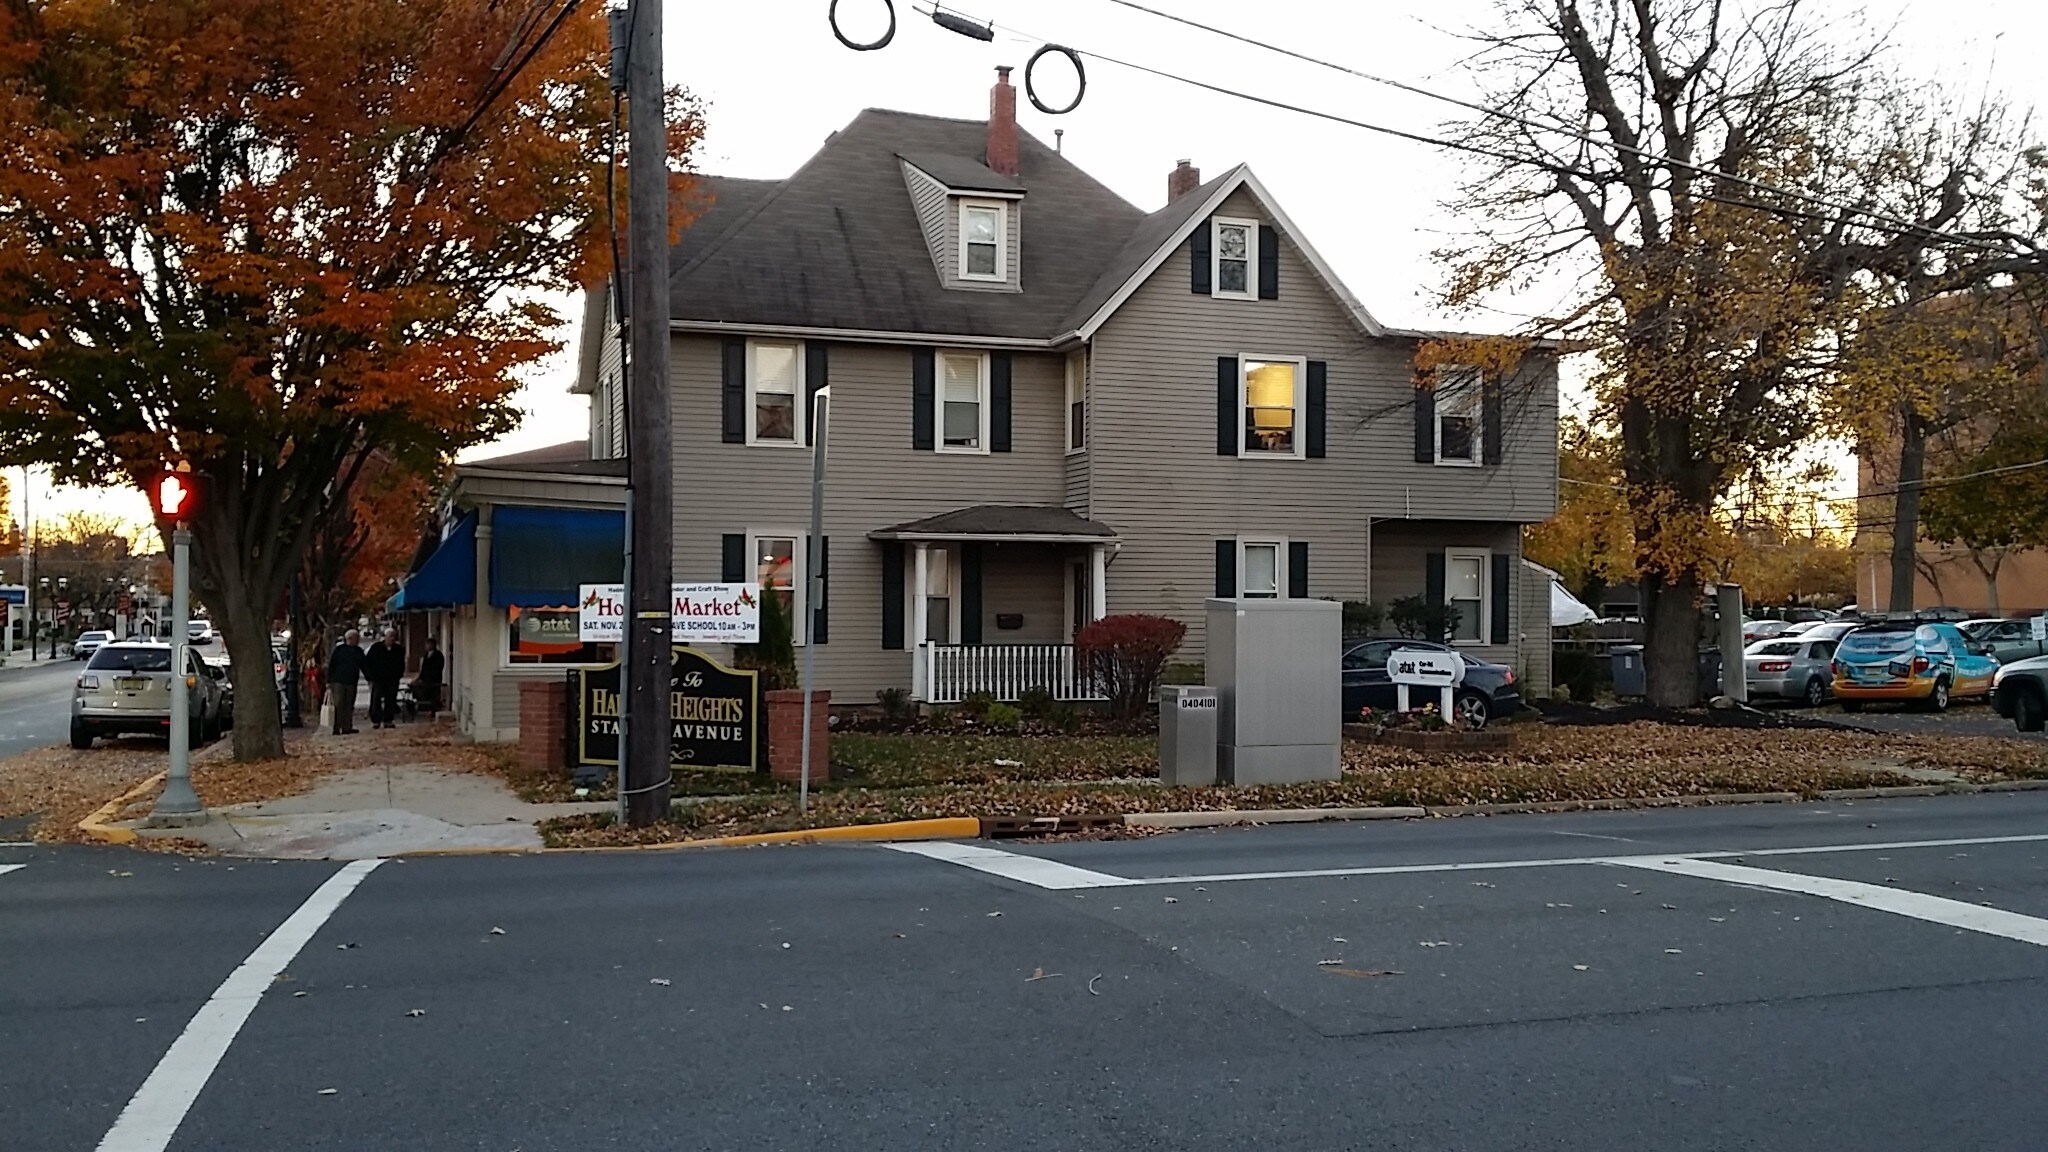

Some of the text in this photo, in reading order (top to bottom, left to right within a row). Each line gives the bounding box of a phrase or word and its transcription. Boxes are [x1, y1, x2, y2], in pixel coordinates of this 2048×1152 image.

[598, 597, 741, 616] Ho Market
[541, 617, 571, 632] at&t
[583, 621, 599, 630] SAT.
[600, 621, 618, 630] NOV.
[687, 621, 718, 630] SCHOOL
[682, 671, 703, 688] To
[670, 691, 744, 723] HEIGHTS
[591, 719, 743, 741] STA AVENUE
